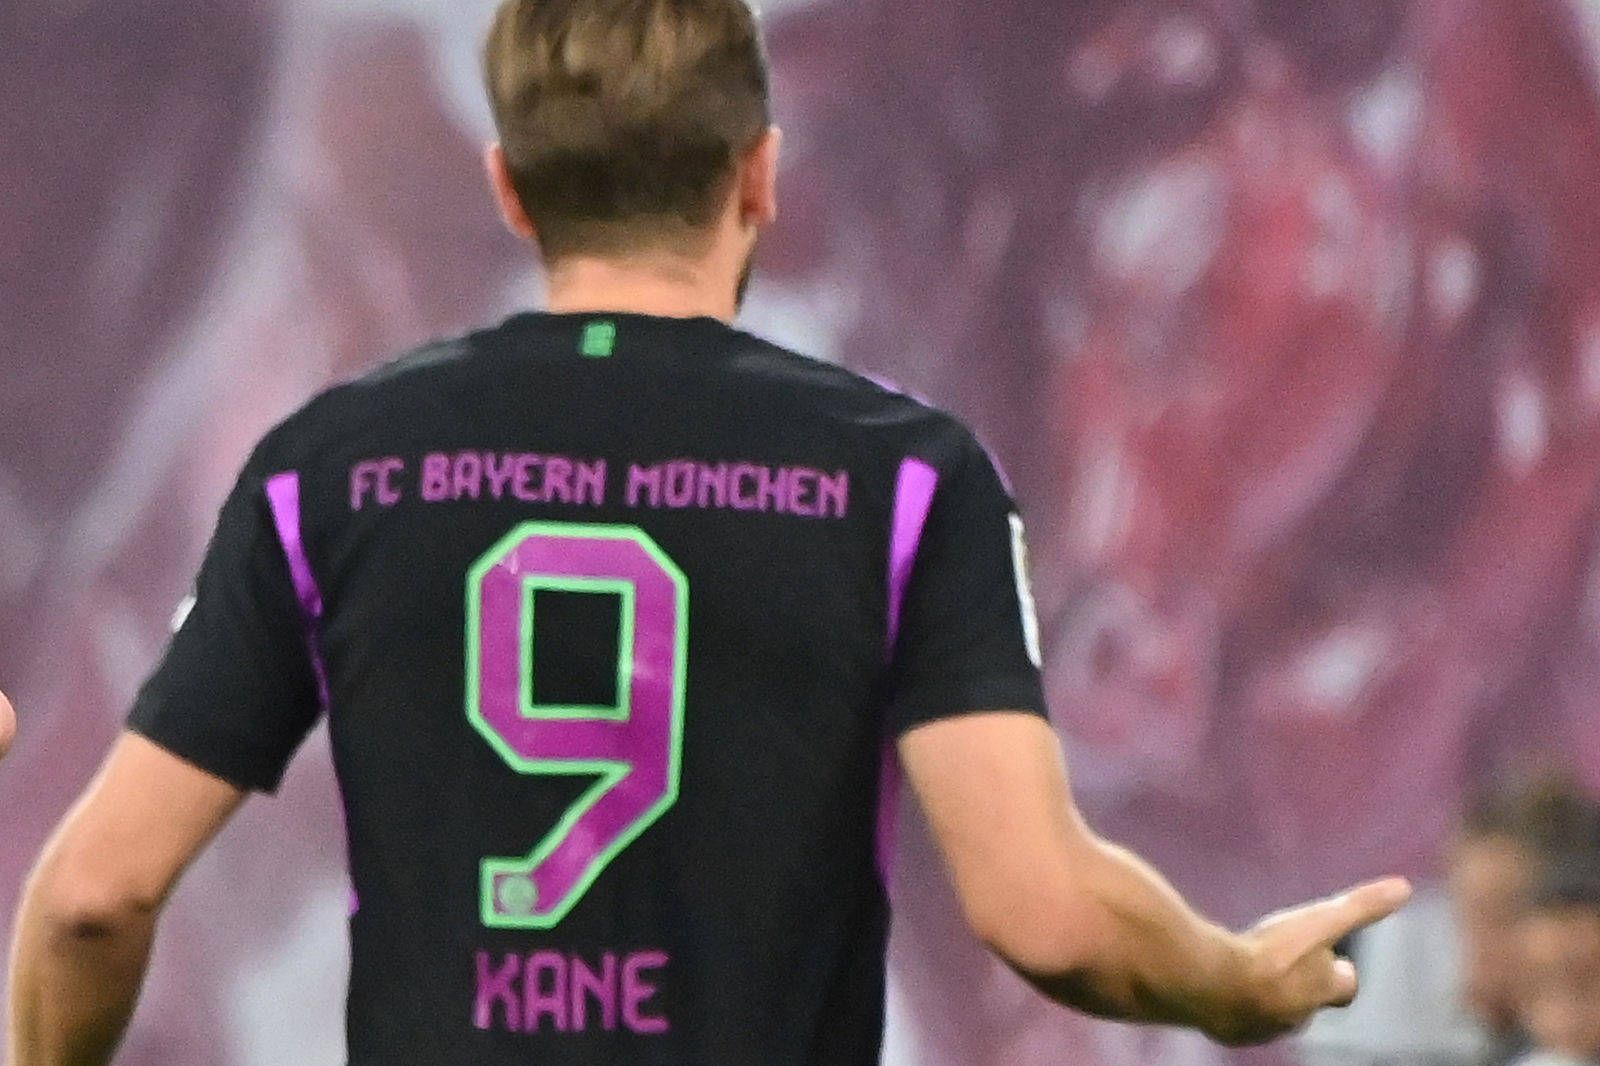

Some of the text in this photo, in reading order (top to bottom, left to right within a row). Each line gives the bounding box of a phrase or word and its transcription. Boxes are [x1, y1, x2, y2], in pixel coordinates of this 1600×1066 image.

[350, 456, 405, 511] FC
[421, 452, 607, 506] BAYERN
[465, 520, 689, 929] 9
[474, 951, 670, 1034] KANE
